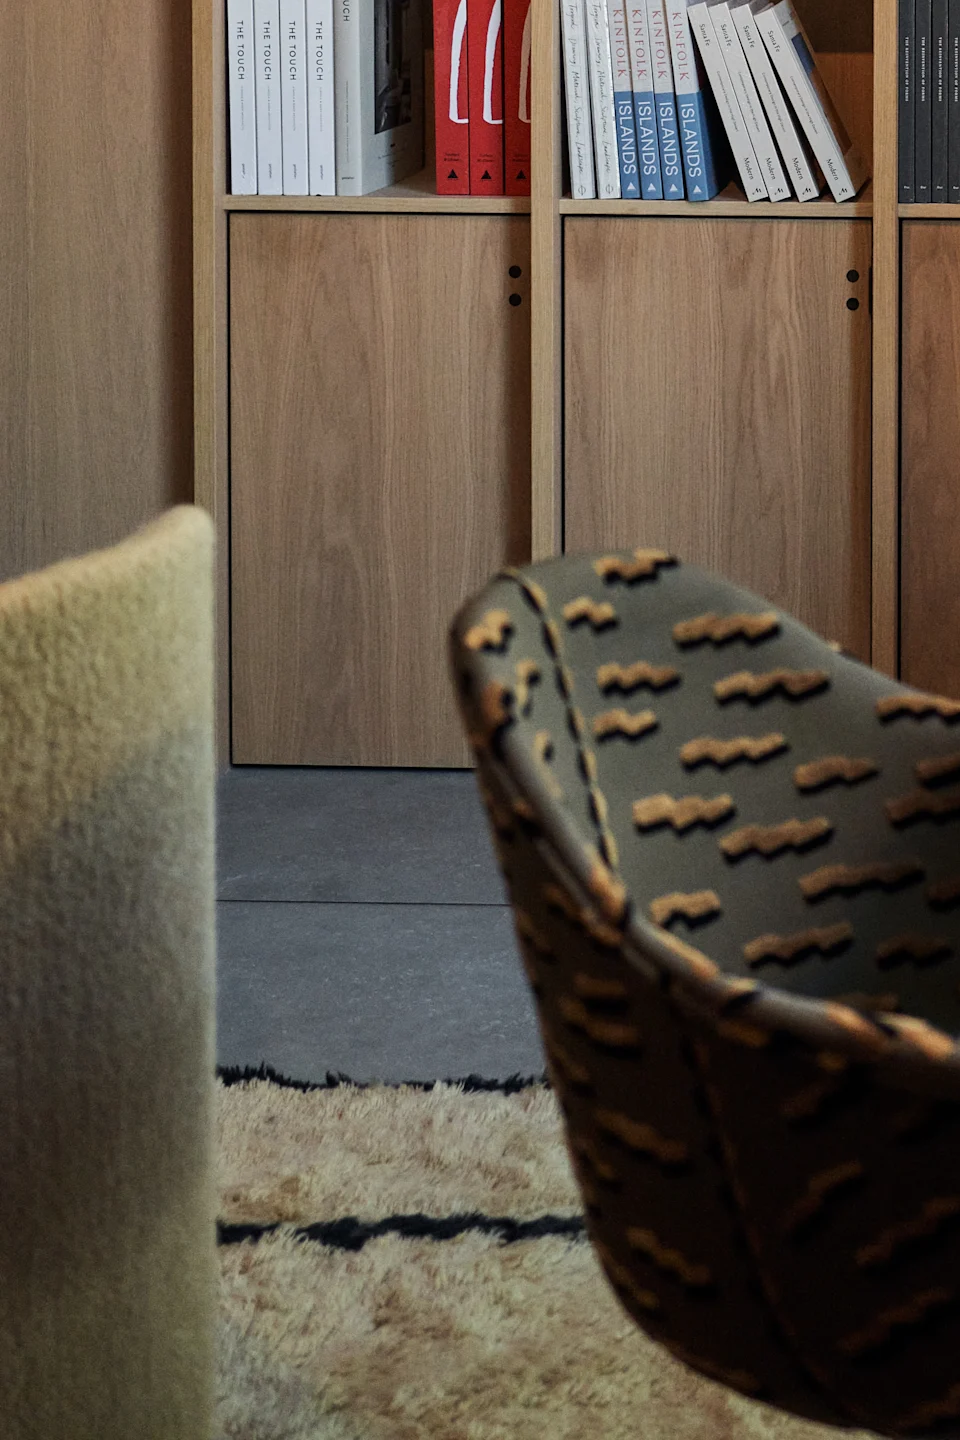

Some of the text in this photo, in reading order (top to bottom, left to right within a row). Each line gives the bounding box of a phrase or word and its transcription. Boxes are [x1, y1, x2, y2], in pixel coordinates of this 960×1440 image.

[236, 20, 245, 80] THE TOUCH
[288, 20, 296, 80] THE TOUCH
[316, 45, 324, 81] TOUCH
[613, 9, 637, 175] KINFOLK ISLANDS
[632, 9, 656, 176] KINFOLK ISLANDS
[652, 10, 678, 176] KINFOLK ISLANDS
[672, 12, 701, 178] KINFOLK ISLANDS
[699, 24, 710, 38] Santa
[743, 157, 755, 180] Modern
[767, 30, 840, 180] Santa Fe Modern
